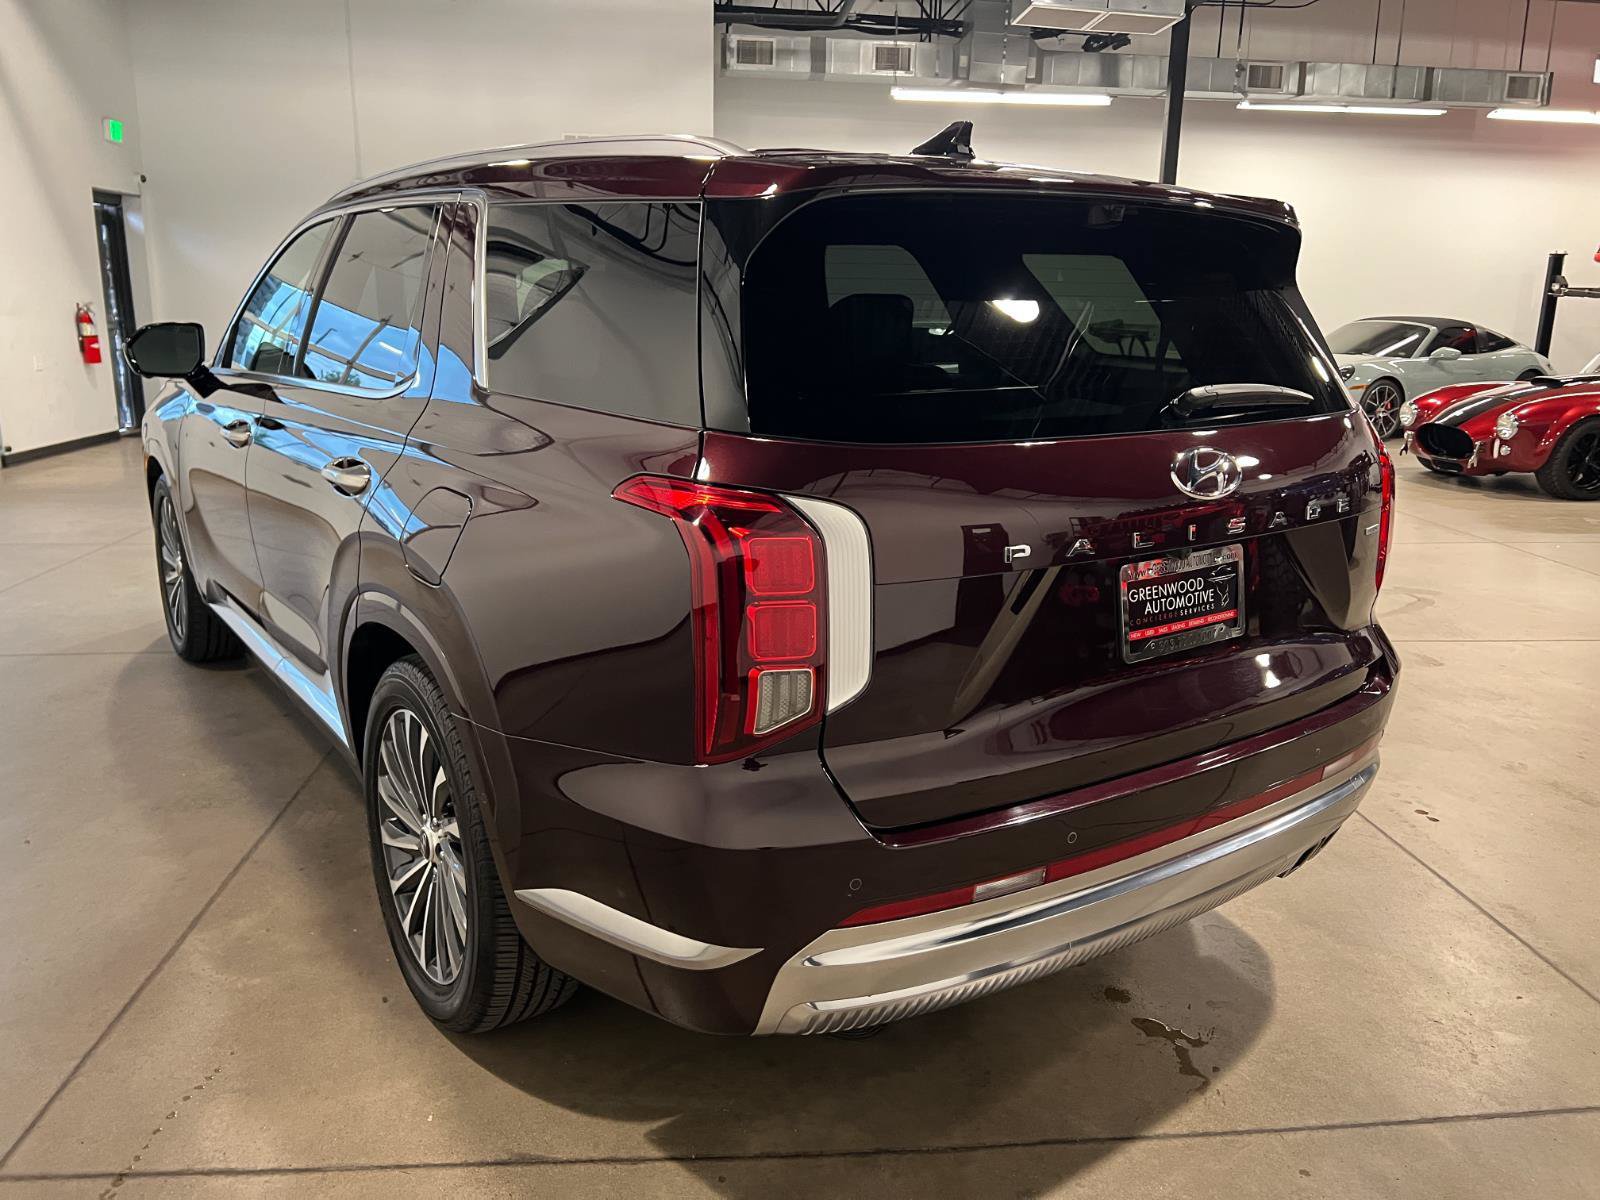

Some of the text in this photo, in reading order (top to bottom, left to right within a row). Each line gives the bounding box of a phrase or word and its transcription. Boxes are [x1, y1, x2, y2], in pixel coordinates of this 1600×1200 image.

[1004, 497, 1350, 564] PALISADE
[1128, 577, 1204, 603] GREENWOOD
[1144, 588, 1215, 615] AUTOMOTIVE
